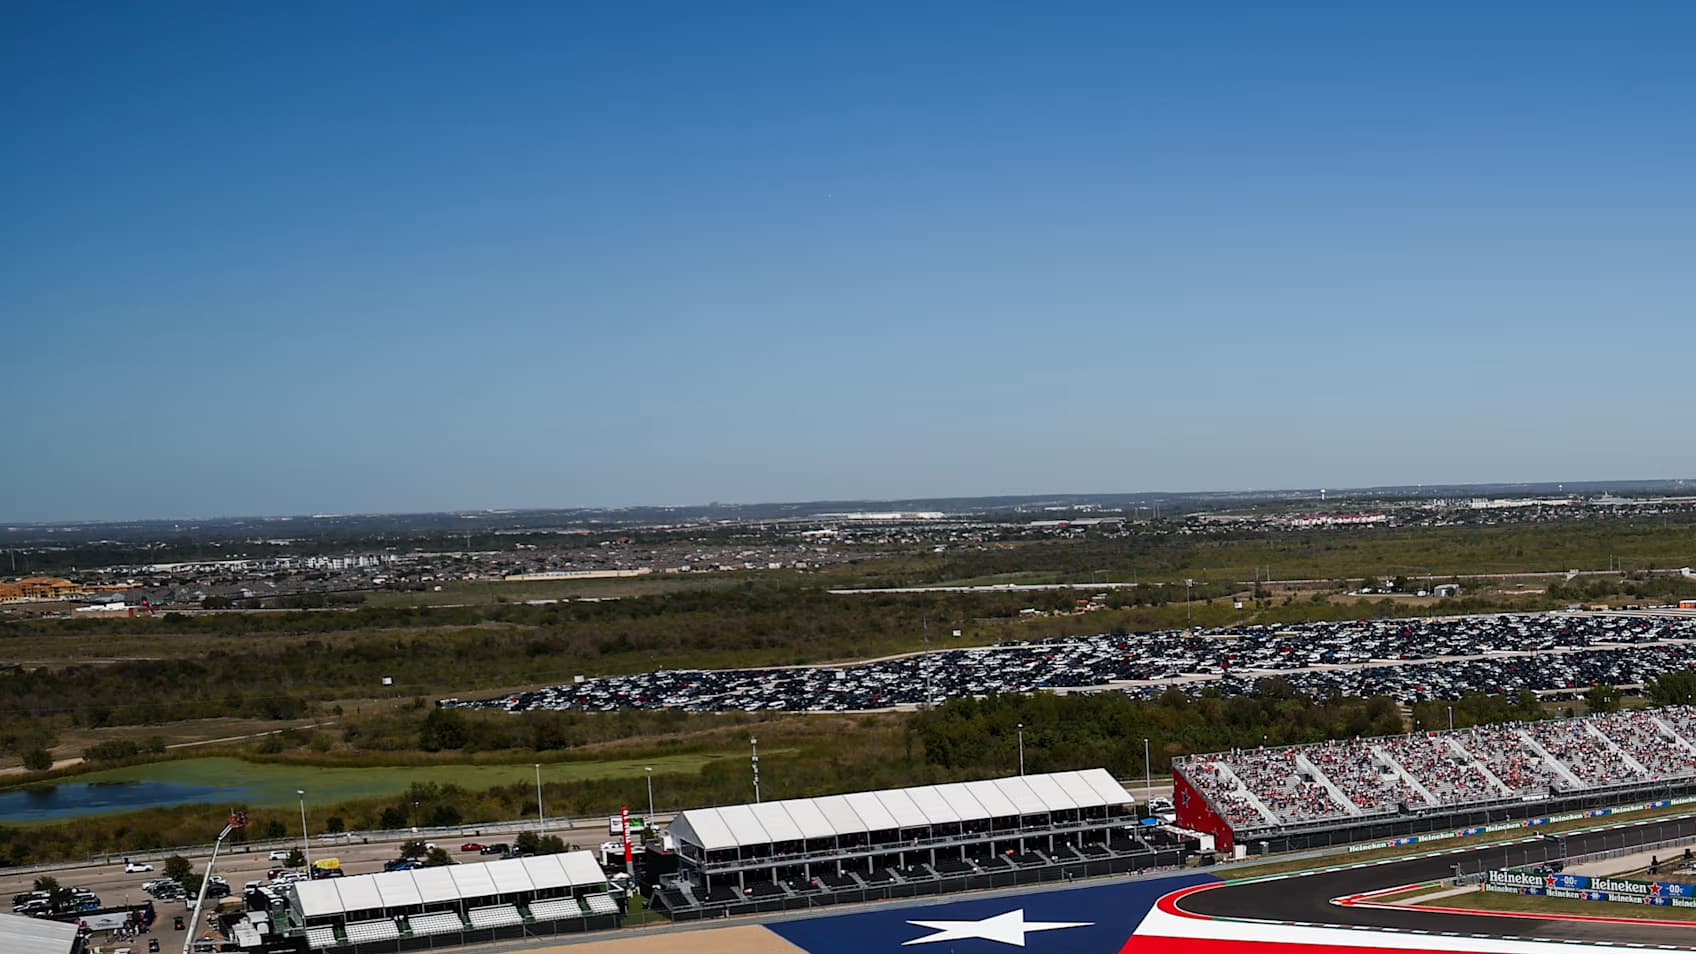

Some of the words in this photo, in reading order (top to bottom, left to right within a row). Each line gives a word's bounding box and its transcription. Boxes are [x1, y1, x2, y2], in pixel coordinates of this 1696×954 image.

[1488, 870, 1543, 885] Heineken
[1485, 884, 1518, 892] Heineken
[1591, 878, 1647, 893] Heineken
[1546, 889, 1579, 899] Heineken
[1608, 893, 1643, 903] Heineken
